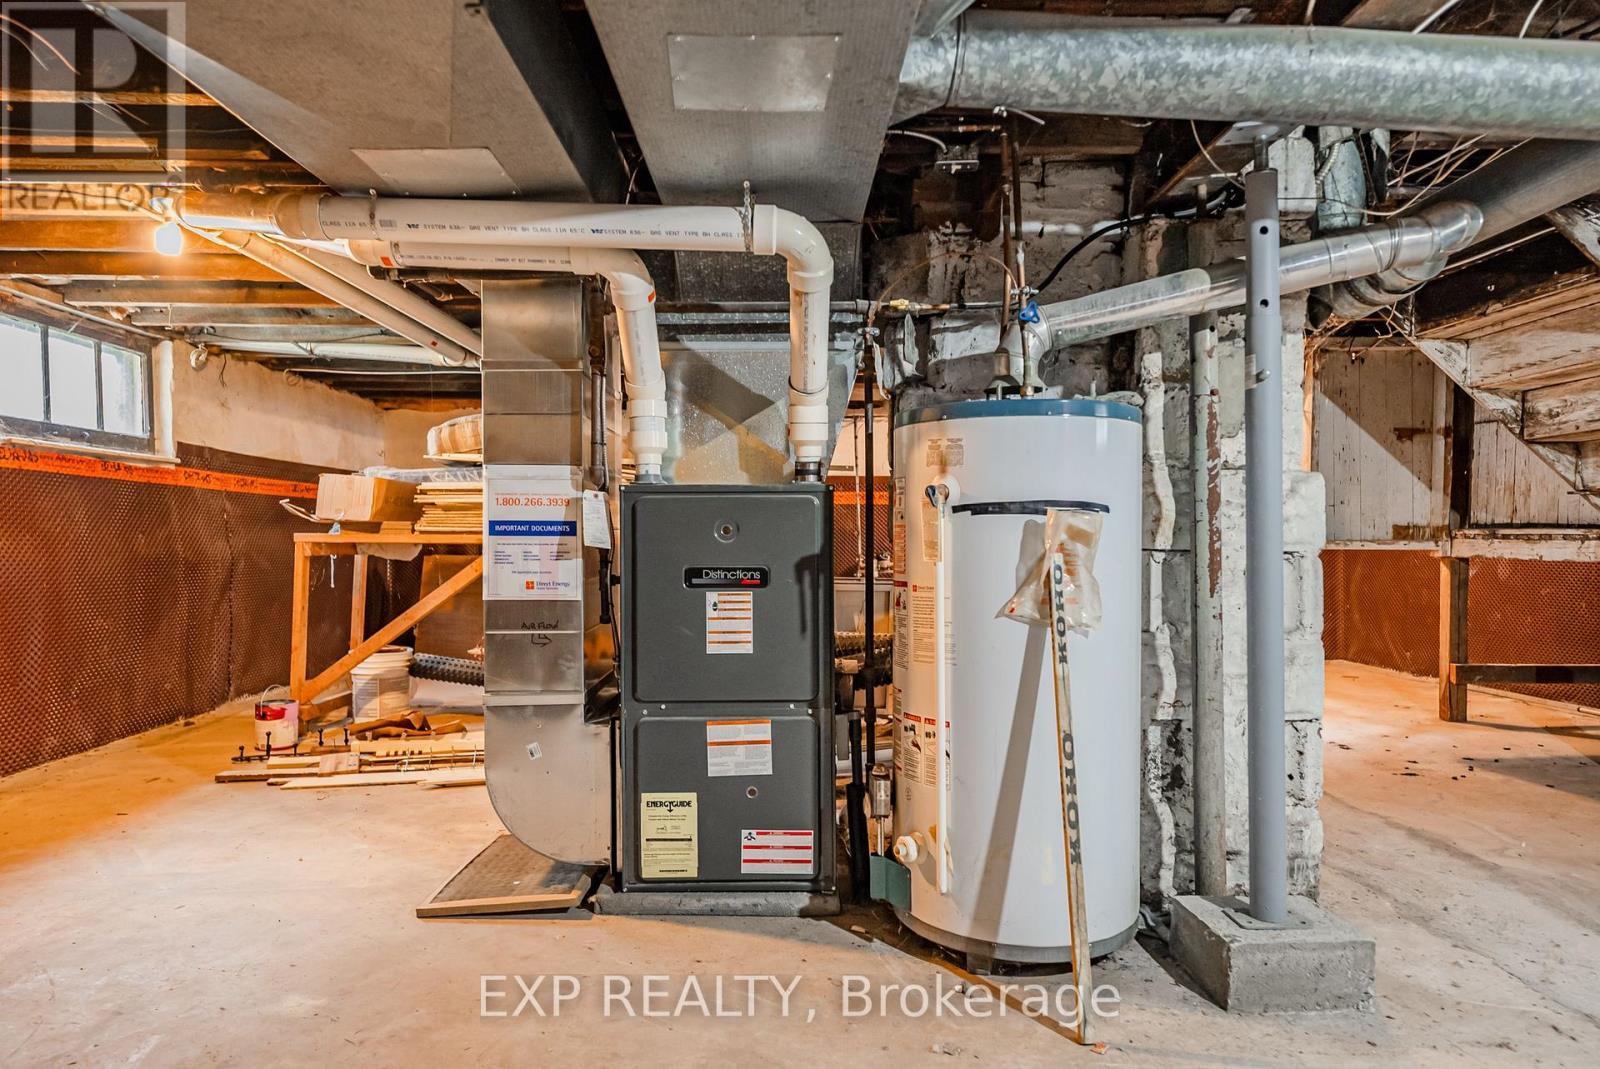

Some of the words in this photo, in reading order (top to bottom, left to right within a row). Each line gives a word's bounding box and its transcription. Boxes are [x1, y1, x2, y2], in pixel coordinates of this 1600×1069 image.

[495, 497, 570, 507] 1.800.266.3939
[702, 569, 761, 579] Distinctions
[646, 800, 693, 812] ENERGYGUIDE
